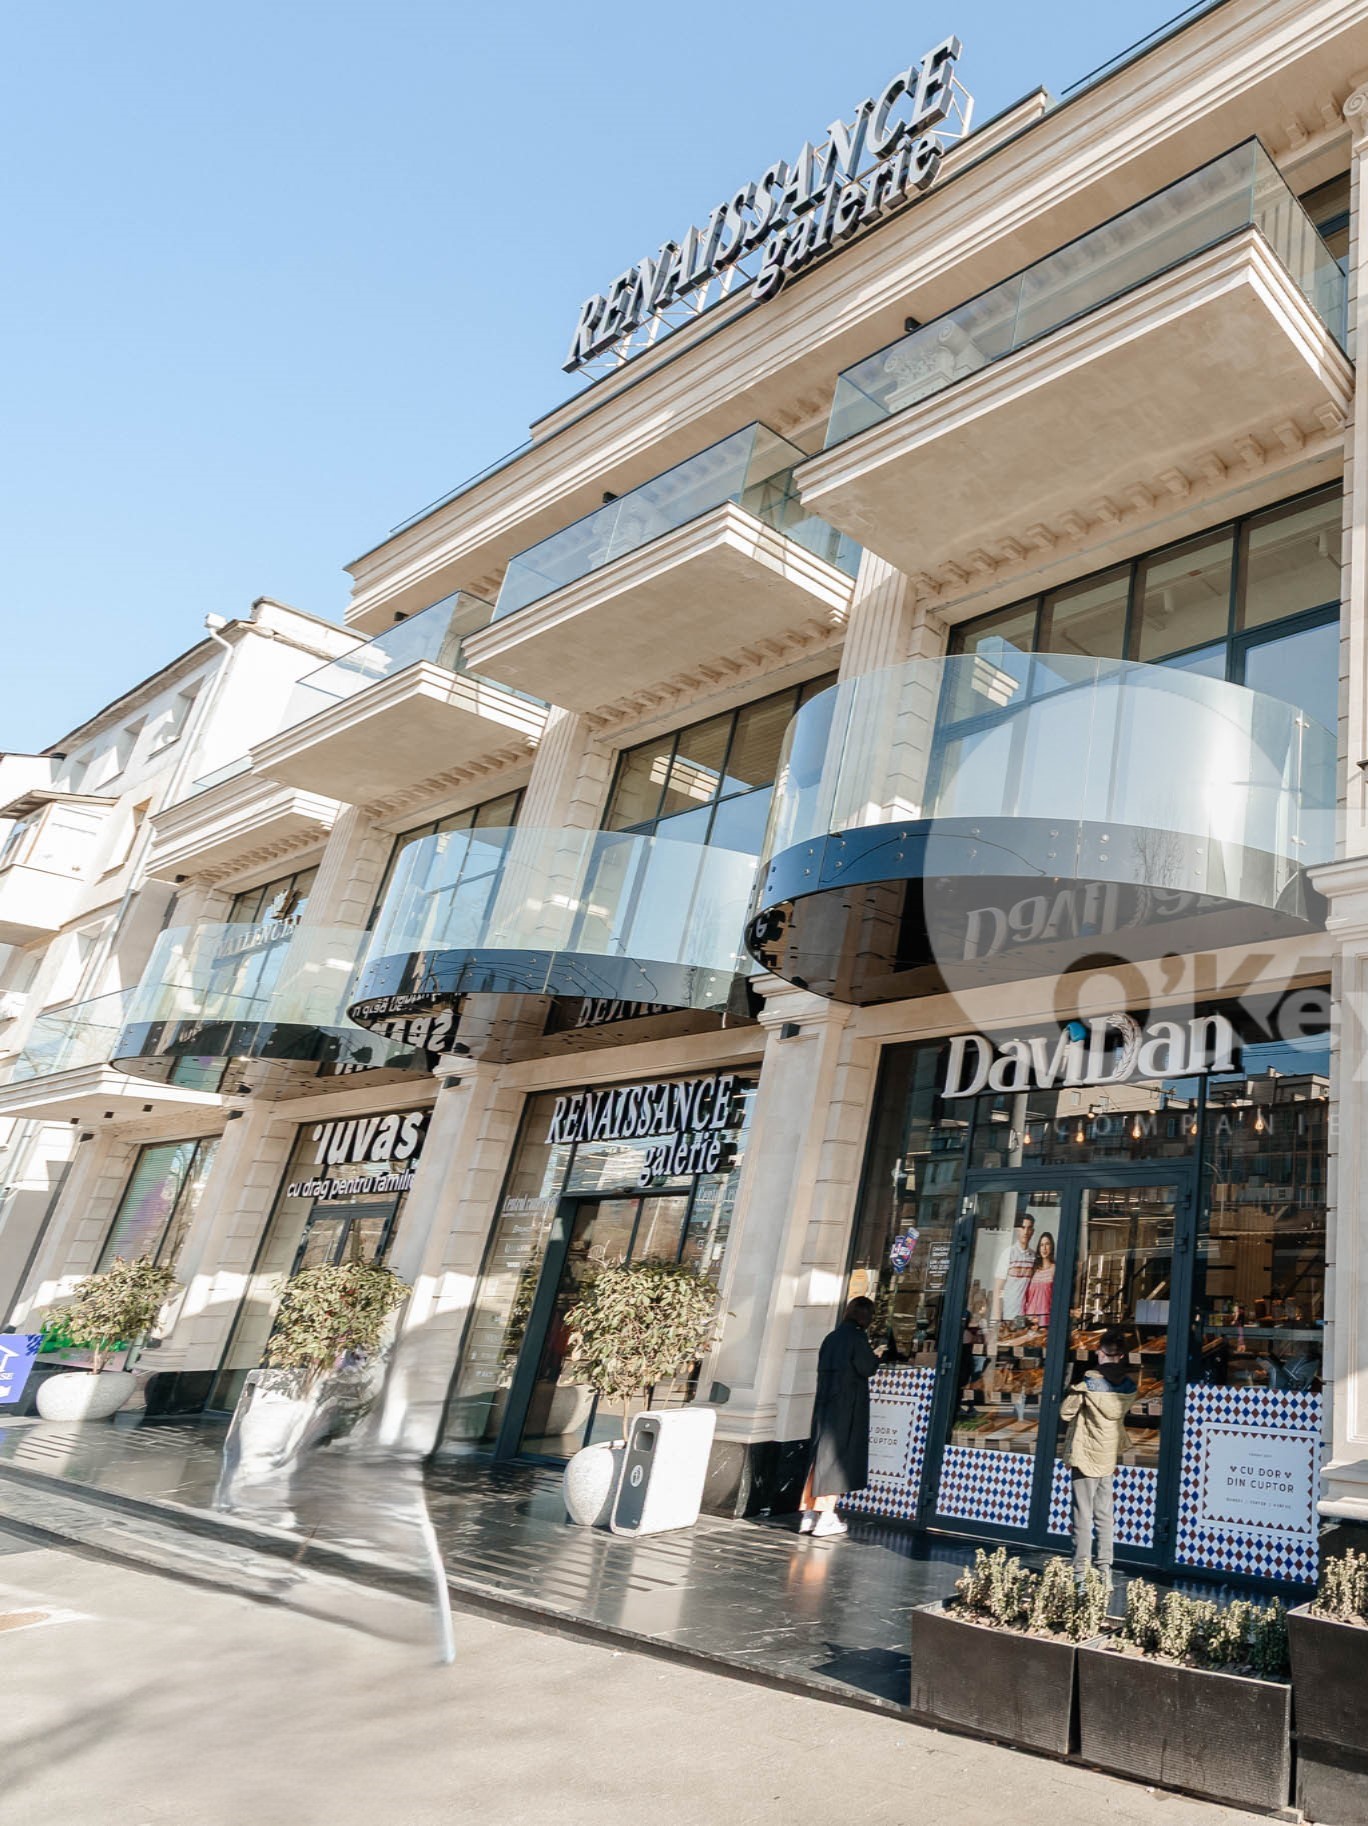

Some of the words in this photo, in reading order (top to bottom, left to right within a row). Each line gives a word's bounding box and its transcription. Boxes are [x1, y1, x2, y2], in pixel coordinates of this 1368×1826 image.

[562, 34, 962, 373] RENAISSANCE
[751, 133, 943, 304] galerie
[941, 1011, 1235, 1099] DaviDan
[545, 1074, 735, 1145] RENAISSANCE
[286, 1182, 302, 1198] cu
[302, 1177, 330, 1200] drag
[329, 1174, 373, 1199] pentru
[637, 1131, 722, 1187] galerie
[1226, 1477, 1246, 1488] DIN
[1249, 1479, 1295, 1494] CUPTOR
[1239, 1465, 1254, 1476] CU
[1258, 1467, 1282, 1479] DOR
